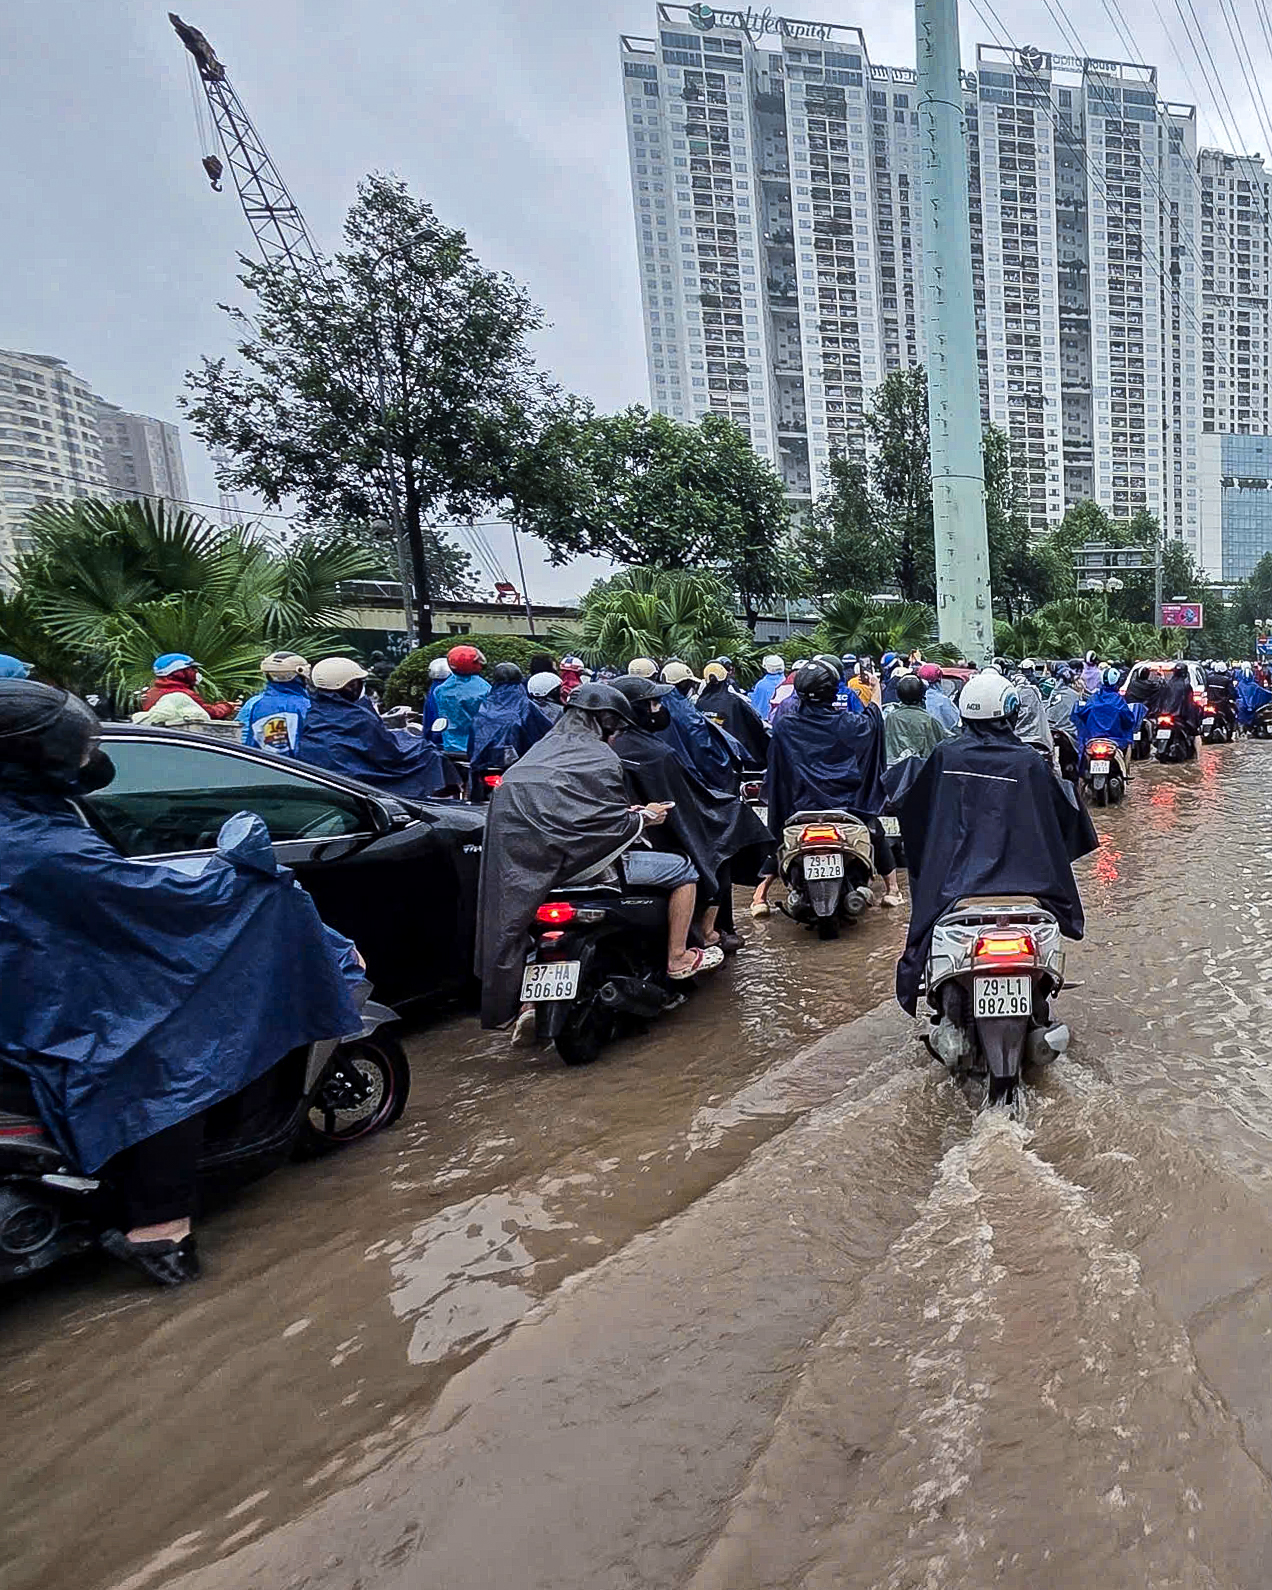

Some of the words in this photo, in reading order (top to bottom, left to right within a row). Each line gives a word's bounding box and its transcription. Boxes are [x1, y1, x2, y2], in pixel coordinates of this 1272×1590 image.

[810, 855, 837, 867] 29-T1
[807, 865, 841, 878] 732.28
[531, 964, 570, 981] 37-HA
[525, 981, 573, 998] 506.69
[983, 978, 1022, 997] 29-L1
[978, 996, 1028, 1015] 982.96
